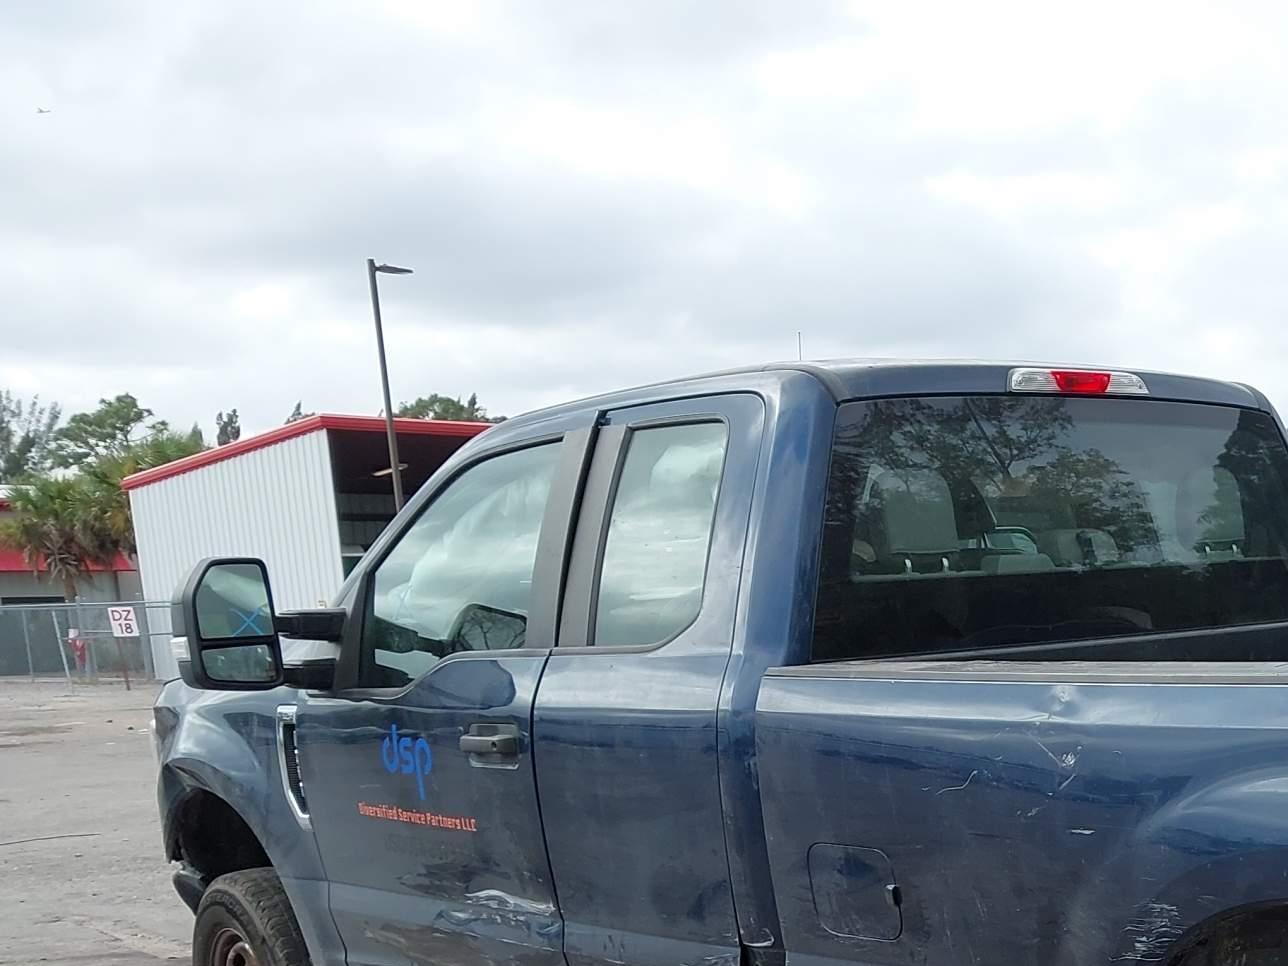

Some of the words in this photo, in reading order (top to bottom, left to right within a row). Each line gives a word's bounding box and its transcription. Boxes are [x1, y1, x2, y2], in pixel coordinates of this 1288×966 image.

[111, 610, 133, 621] DZ
[118, 623, 134, 634] 18
[358, 802, 398, 820] Diversified
[398, 808, 426, 825] Service
[425, 812, 462, 830] Partners
[461, 816, 477, 832] LLC
